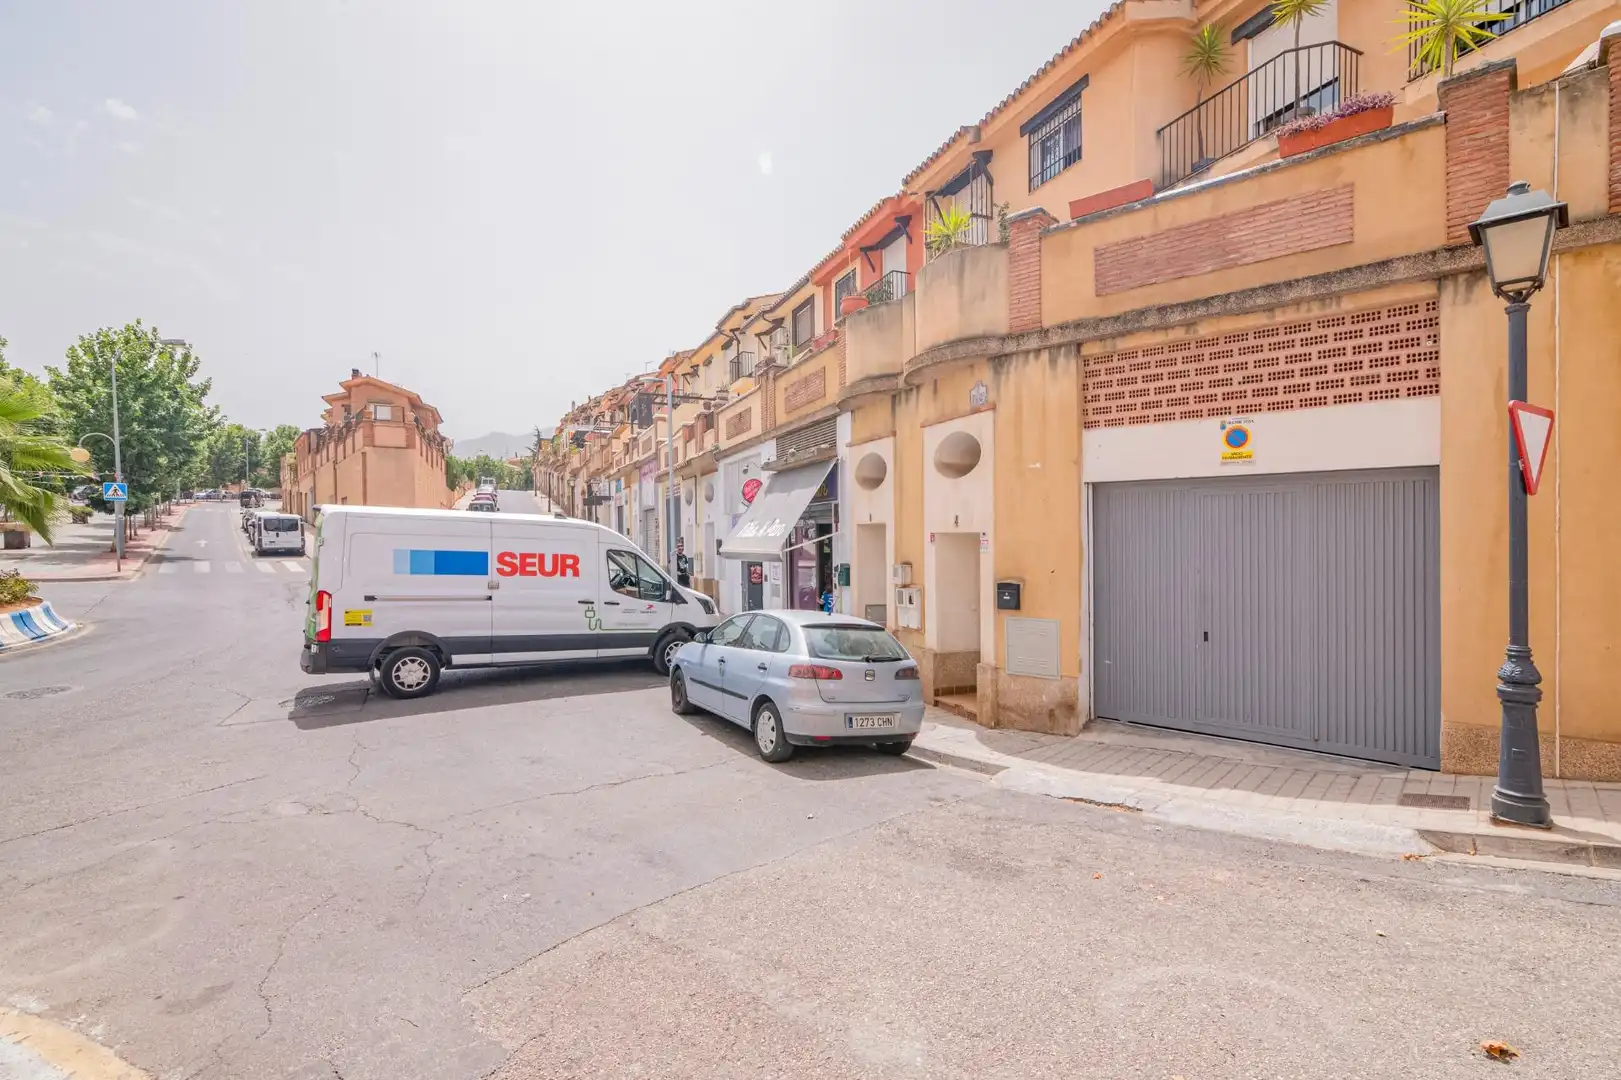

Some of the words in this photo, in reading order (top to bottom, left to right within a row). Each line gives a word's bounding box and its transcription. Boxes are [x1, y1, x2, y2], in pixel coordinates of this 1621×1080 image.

[496, 550, 580, 577] SEUR
[854, 716, 875, 727] 1273
[877, 716, 893, 727] CHN
